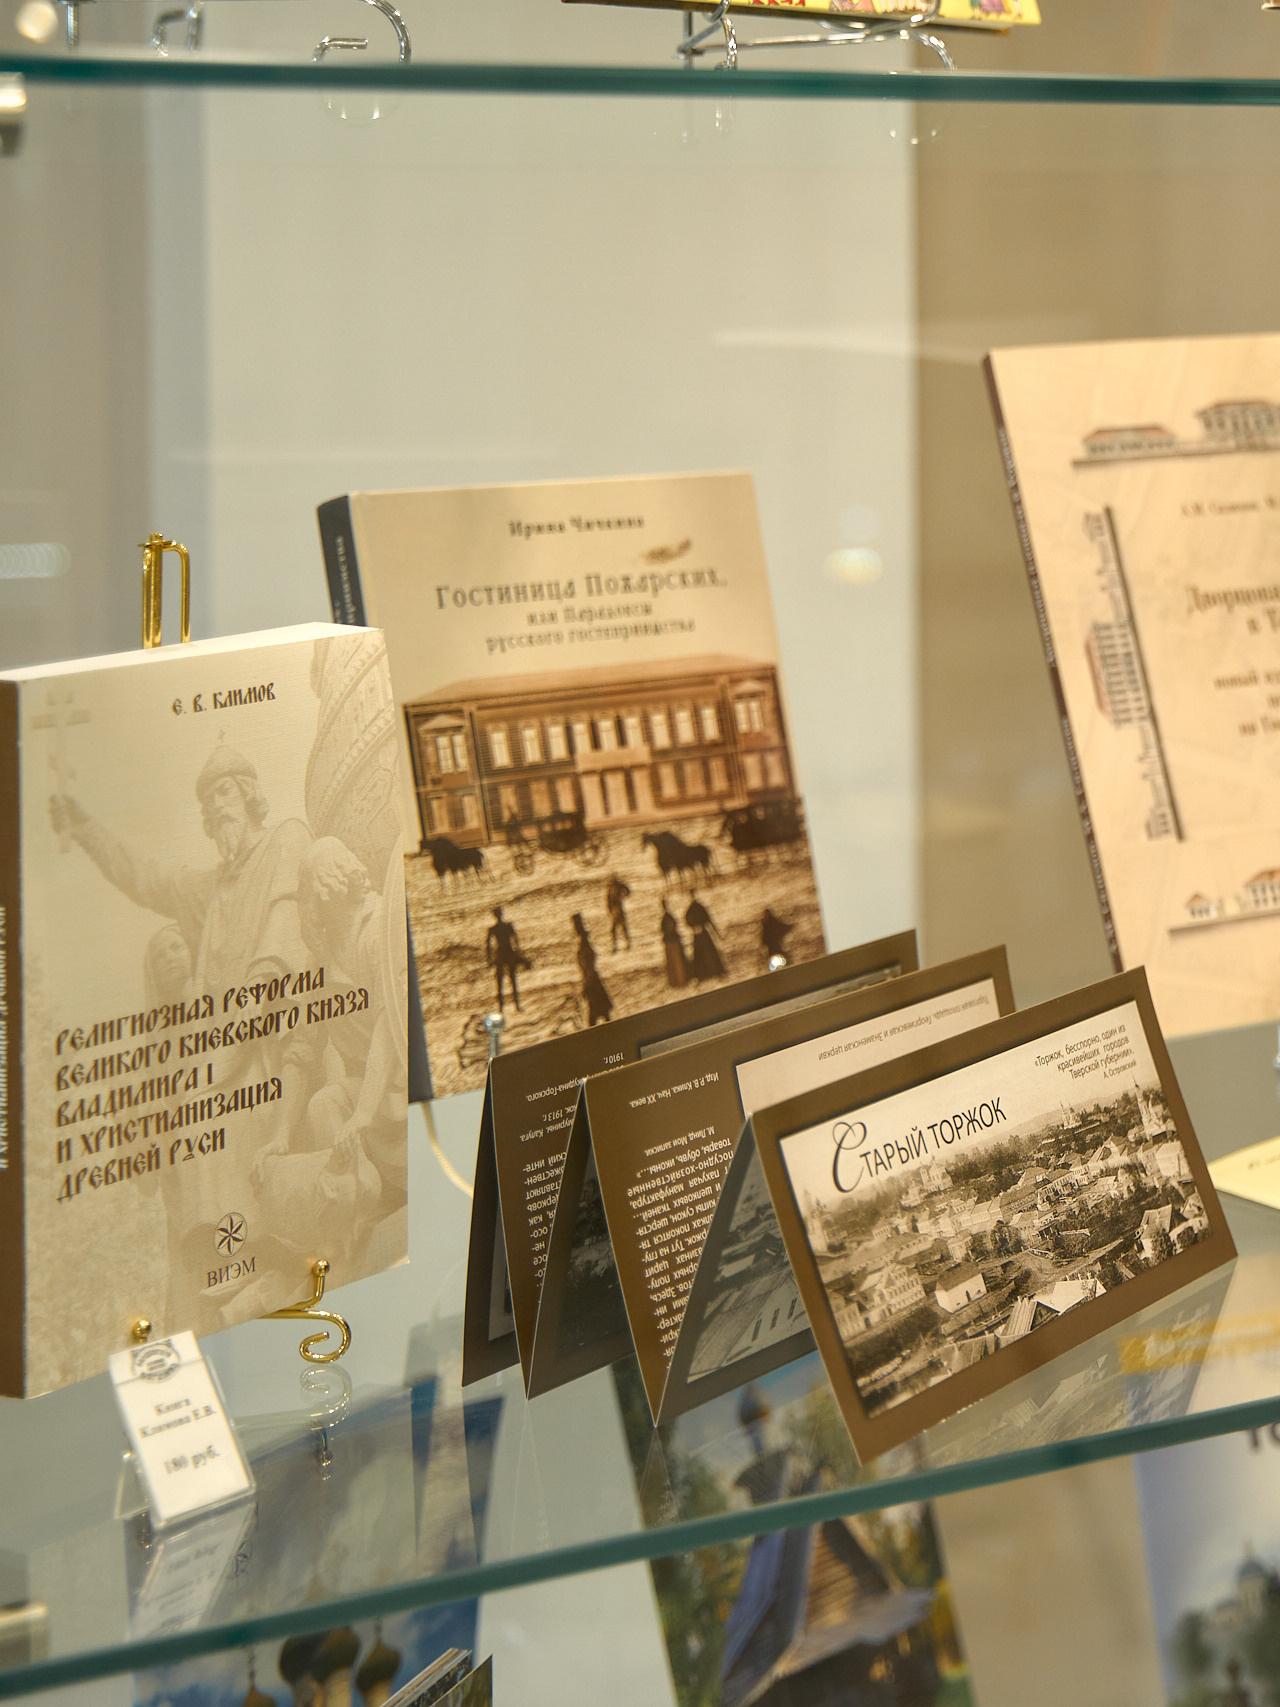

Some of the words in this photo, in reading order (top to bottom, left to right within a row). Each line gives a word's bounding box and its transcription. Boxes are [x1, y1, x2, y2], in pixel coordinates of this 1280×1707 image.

[193, 693, 207, 713] В.
[55, 994, 215, 1056] РЕЛИГИОЗНАЯ
[223, 967, 326, 1014] РЕФОРМА
[889, 1015, 932, 1038] Георгиевская
[55, 1039, 172, 1092] ВЕЛИКОГО
[179, 1006, 299, 1059] КИЕВСКОГО
[306, 987, 370, 1025] КНЯЗЯ
[843, 1033, 883, 1052] Знаменская
[1034, 1049, 1065, 1067] «Торжок,
[1065, 1035, 1101, 1055] бесспорно,
[1101, 1028, 1117, 1040] один
[1118, 1024, 1127, 1034] из
[609, 1052, 624, 1064] 1910
[817, 1046, 844, 1061] церкви
[1057, 1047, 1101, 1073] красивейших
[1103, 1036, 1130, 1053] городов
[705, 1072, 719, 1082] Изд.
[1069, 1059, 1101, 1080] Тверской
[1108, 1059, 1137, 1078] Островский
[692, 1079, 699, 1088] В.
[699, 1077, 706, 1086] Р.
[55, 1066, 199, 1128] ВЛАДИМИРА
[629, 1097, 646, 1108] века.
[56, 1137, 73, 1164] И
[80, 1076, 283, 1157] ХРИСТИАНИЗАЦИЯ
[548, 1109, 563, 1122] 1913
[927, 1096, 1008, 1149] ТОРЖОК
[519, 1128, 544, 1143] Калуга.
[706, 1126, 715, 1136] М.
[644, 1141, 672, 1156] записки.
[673, 1136, 688, 1147] Мои
[701, 1138, 731, 1154] товары,
[676, 1149, 701, 1163] обувь,
[56, 1143, 162, 1205] ДРЕВНЕЙ
[168, 1127, 226, 1165] РУСИ
[627, 1151, 734, 1197] посудно-хозяйственные
[689, 1169, 719, 1188] пахучая
[630, 1183, 684, 1209] мануфактура,
[673, 1186, 712, 1208] шелковых
[528, 1214, 543, 1227] как
[670, 1206, 695, 1223] сукон,
[636, 1217, 668, 1236] шерстя-
[653, 1223, 690, 1246] покоятся
[639, 1239, 652, 1250] тя-
[660, 1246, 670, 1256] на
[671, 1239, 685, 1253] Тут
[642, 1251, 658, 1263] глу-
[206, 1256, 257, 1288] ВИЭМ
[644, 1260, 669, 1278] царит
[648, 1274, 671, 1290] полу-
[650, 1286, 676, 1303] Здесь,
[154, 1399, 191, 1416] Книга
[163, 1457, 188, 1475] 180
[192, 1445, 220, 1469] руб.
